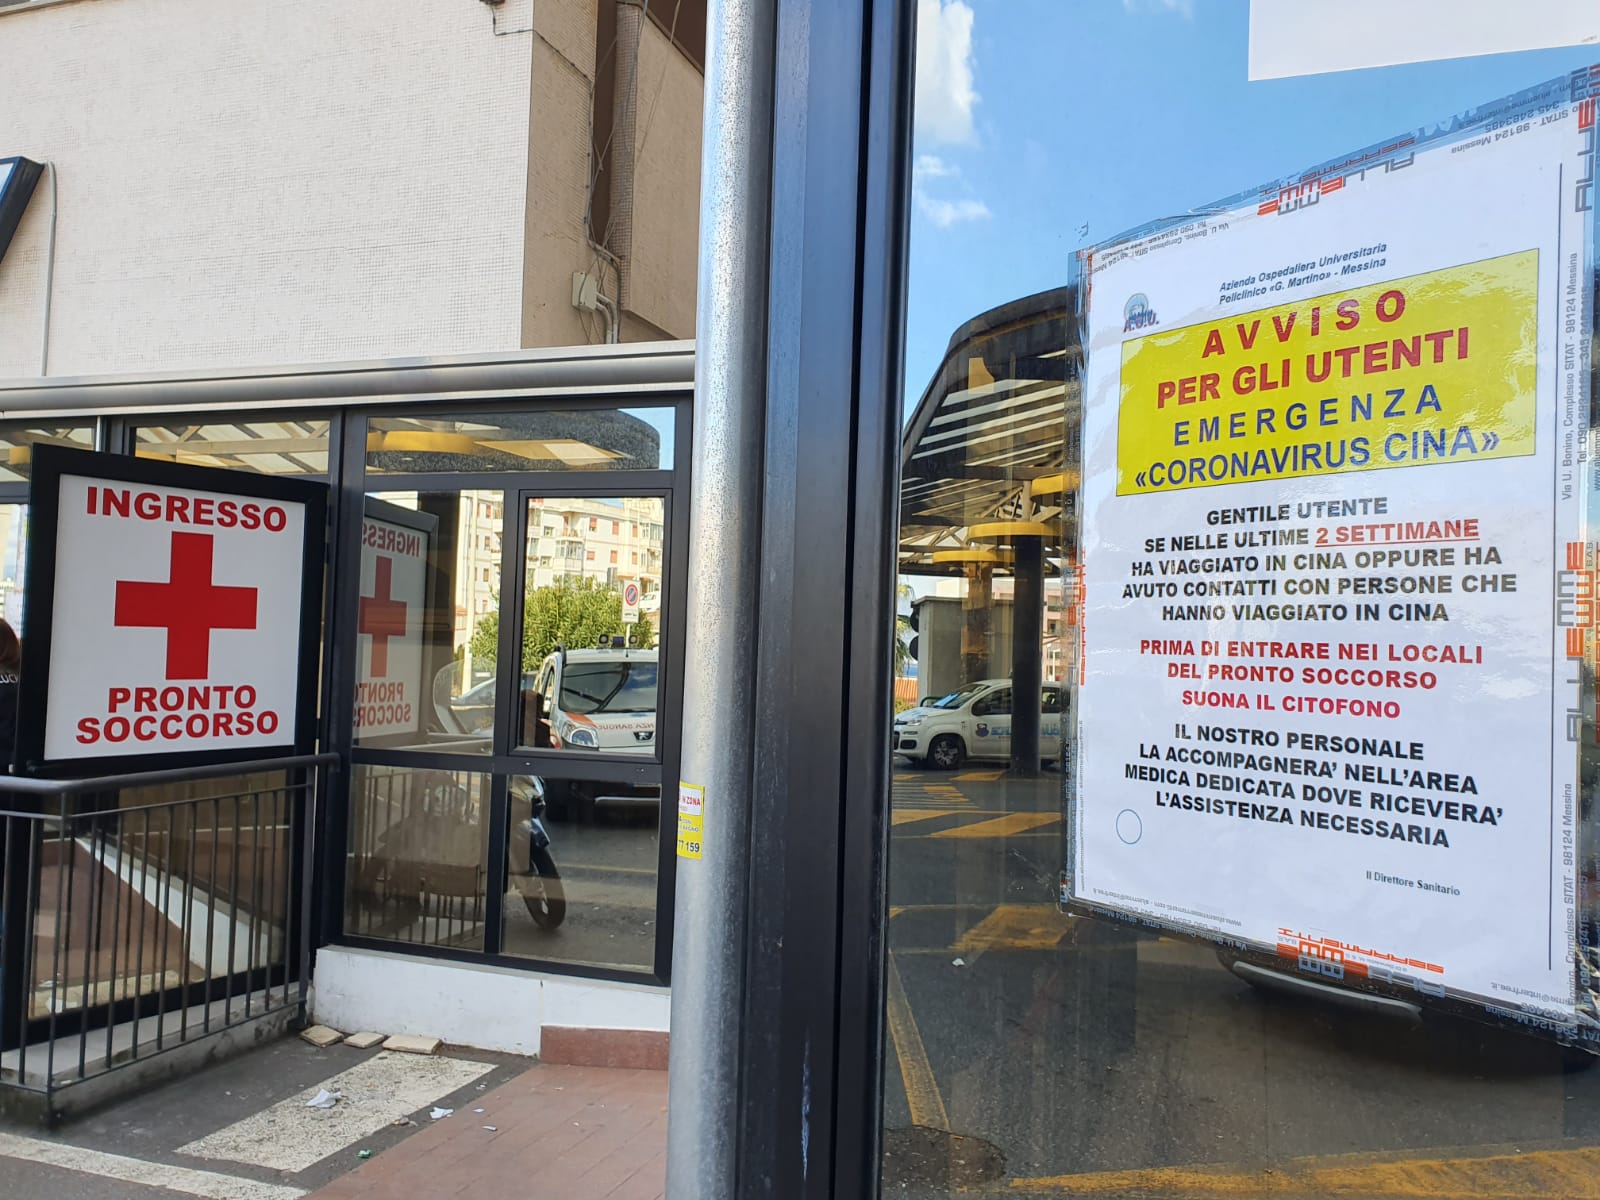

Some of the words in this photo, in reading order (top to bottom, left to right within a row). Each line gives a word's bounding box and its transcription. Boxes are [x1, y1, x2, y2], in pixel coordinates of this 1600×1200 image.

[1451, 137, 1491, 153] Messina
[1495, 122, 1530, 139] 98124
[1219, 275, 1256, 292] Azienda
[1258, 261, 1316, 283] Ospedaliera
[1318, 243, 1387, 267] Universitaria
[1219, 286, 1267, 304] Policlinico
[1270, 281, 1285, 292] «G.
[1287, 271, 1331, 288] Martino»
[1341, 257, 1387, 276] Messina
[1567, 252, 1578, 295] Messina
[1202, 290, 1406, 358] AVVISO
[1567, 300, 1577, 334] 98124
[1157, 373, 1221, 409] PER
[1232, 358, 1291, 395] GLI
[1306, 327, 1469, 383] UTENTI
[1565, 341, 1576, 371] SITAT
[1174, 384, 1442, 446] EMERGENZA
[1564, 372, 1576, 426] Complesso
[1135, 437, 1370, 487] «CORONAVIRUS
[1384, 426, 1500, 461] CINA»
[87, 486, 287, 532] INGRESSO
[1207, 504, 1290, 526] GENTILE
[1297, 497, 1388, 519] UTENTE
[1144, 538, 1165, 553] SE
[1171, 533, 1228, 551] NELLE
[1234, 528, 1309, 548] ULTIME
[1316, 527, 1329, 544] 2
[1335, 518, 1479, 543] SETTIMANE
[1131, 561, 1154, 576] HA
[1159, 556, 1259, 575] VIAGGIATO
[1265, 555, 1286, 571] IN
[1293, 552, 1347, 570] CINA
[1354, 548, 1455, 568] OPPURE
[1464, 546, 1502, 565] HA
[1122, 582, 1178, 598] AVUTO
[1183, 579, 1277, 597] CONTATTI
[1284, 578, 1329, 595] CON
[1338, 575, 1453, 595] PERSONE
[1461, 574, 1517, 593] CHE
[1162, 605, 1226, 621] HANNO
[1232, 604, 1348, 621] VIAGGIATO
[1356, 604, 1379, 621] IN
[1388, 603, 1449, 622] CINA
[1140, 639, 1195, 656] PRIMA
[1201, 641, 1219, 657] DI
[1227, 641, 1330, 659] ENTRARE
[1338, 643, 1378, 661] NEI
[1388, 644, 1482, 664] LOCALI
[1168, 662, 1201, 679] DEL
[1208, 664, 1294, 683] PRONTO
[1302, 667, 1437, 690] SOCCORSO
[108, 685, 257, 713] PRONTO
[1182, 690, 1250, 709] SUONA
[1256, 694, 1275, 711] IL
[1282, 695, 1401, 719] CITOFONO
[75, 711, 279, 744] SOCCORSO
[1175, 723, 1191, 740] IL
[1197, 724, 1280, 747] NOSTRO
[1286, 732, 1424, 761] PERSONALE
[1139, 743, 1160, 760] LA
[1165, 746, 1337, 778] ACCOMPAGNERA'
[1344, 762, 1479, 795] NELL'AREA
[1124, 763, 1190, 787] MEDICA
[1196, 772, 1296, 800] DEDICATA
[1302, 784, 1362, 808] DOVE
[1370, 792, 1504, 826] RICEVERA'
[1562, 783, 1572, 826] Messina
[1156, 790, 1294, 825] L'ASSISTENZA
[1300, 809, 1450, 848] NECESSARIA
[686, 842, 700, 853] 159
[1562, 830, 1573, 866] 98124
[1366, 870, 1372, 880] Il
[1374, 871, 1414, 888] Direttore
[1416, 879, 1461, 896] Sanitario
[1563, 876, 1573, 905] SITAT
